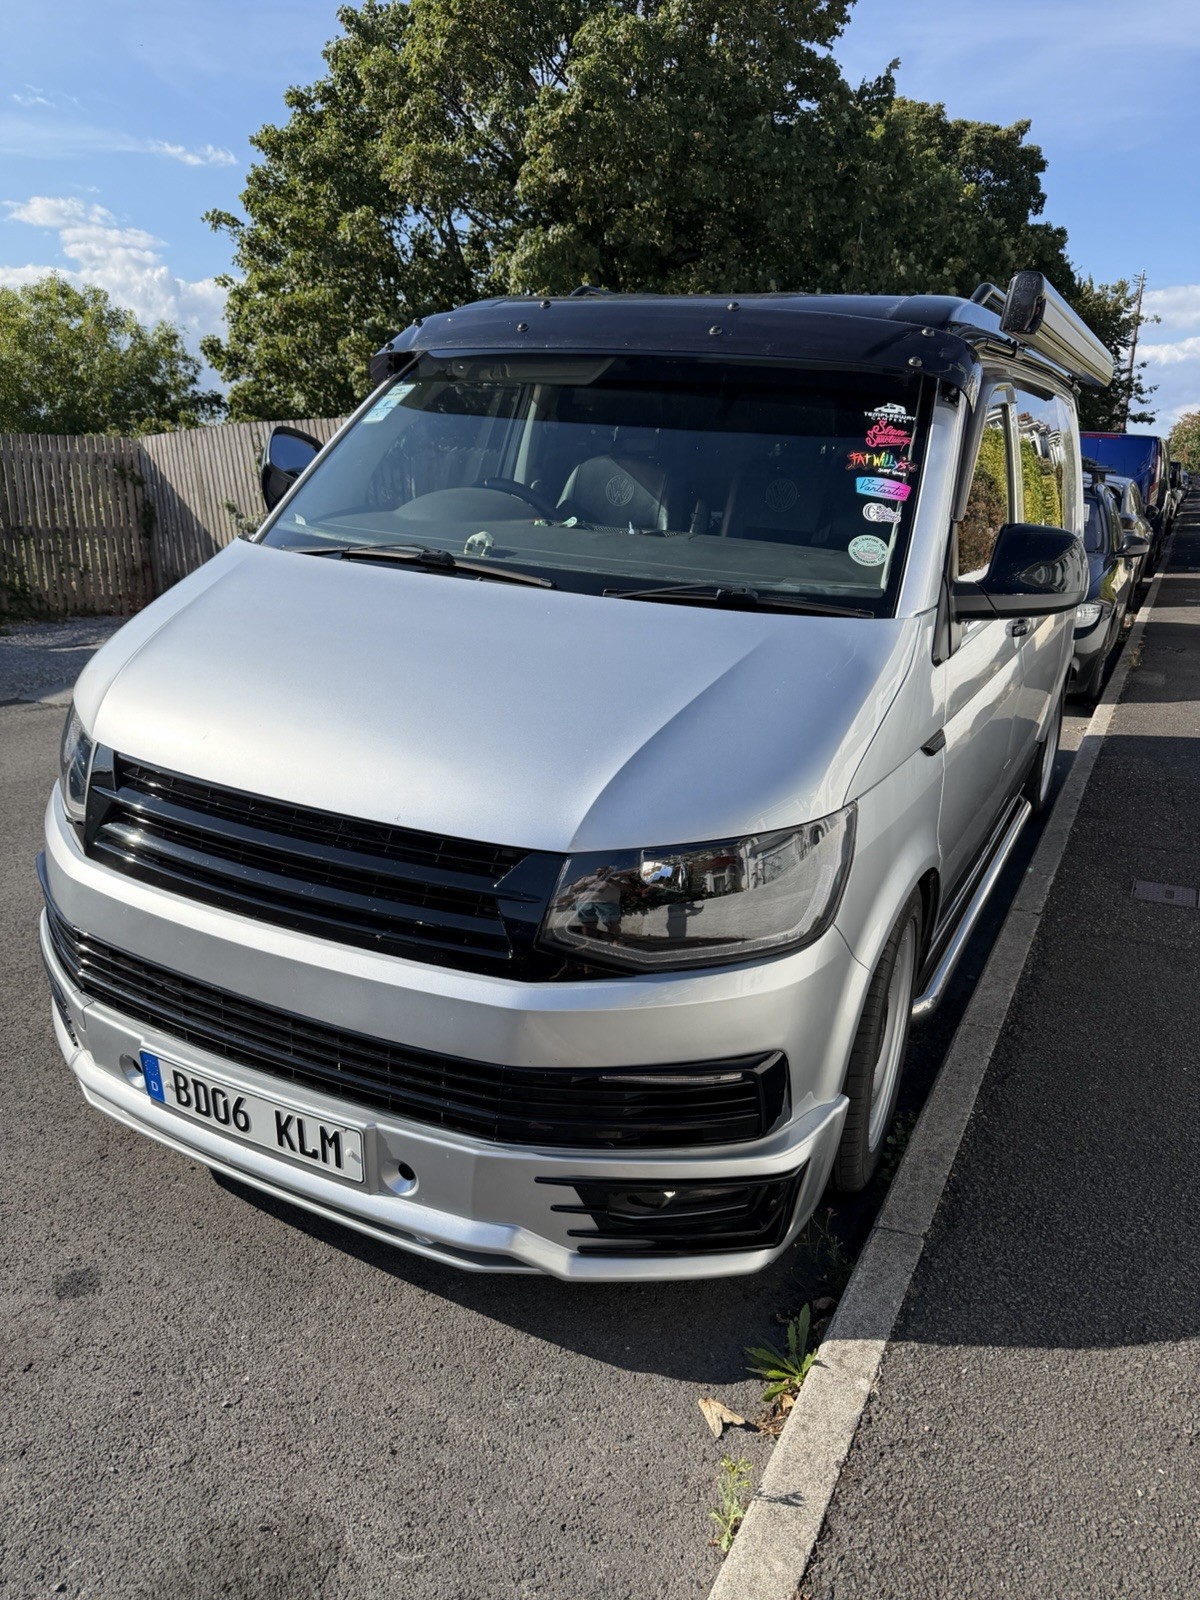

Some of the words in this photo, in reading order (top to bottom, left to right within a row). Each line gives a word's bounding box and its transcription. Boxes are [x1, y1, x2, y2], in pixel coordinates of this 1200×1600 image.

[151, 1080, 159, 1092] D
[172, 1069, 250, 1133] BD06
[274, 1110, 342, 1169] KLM
